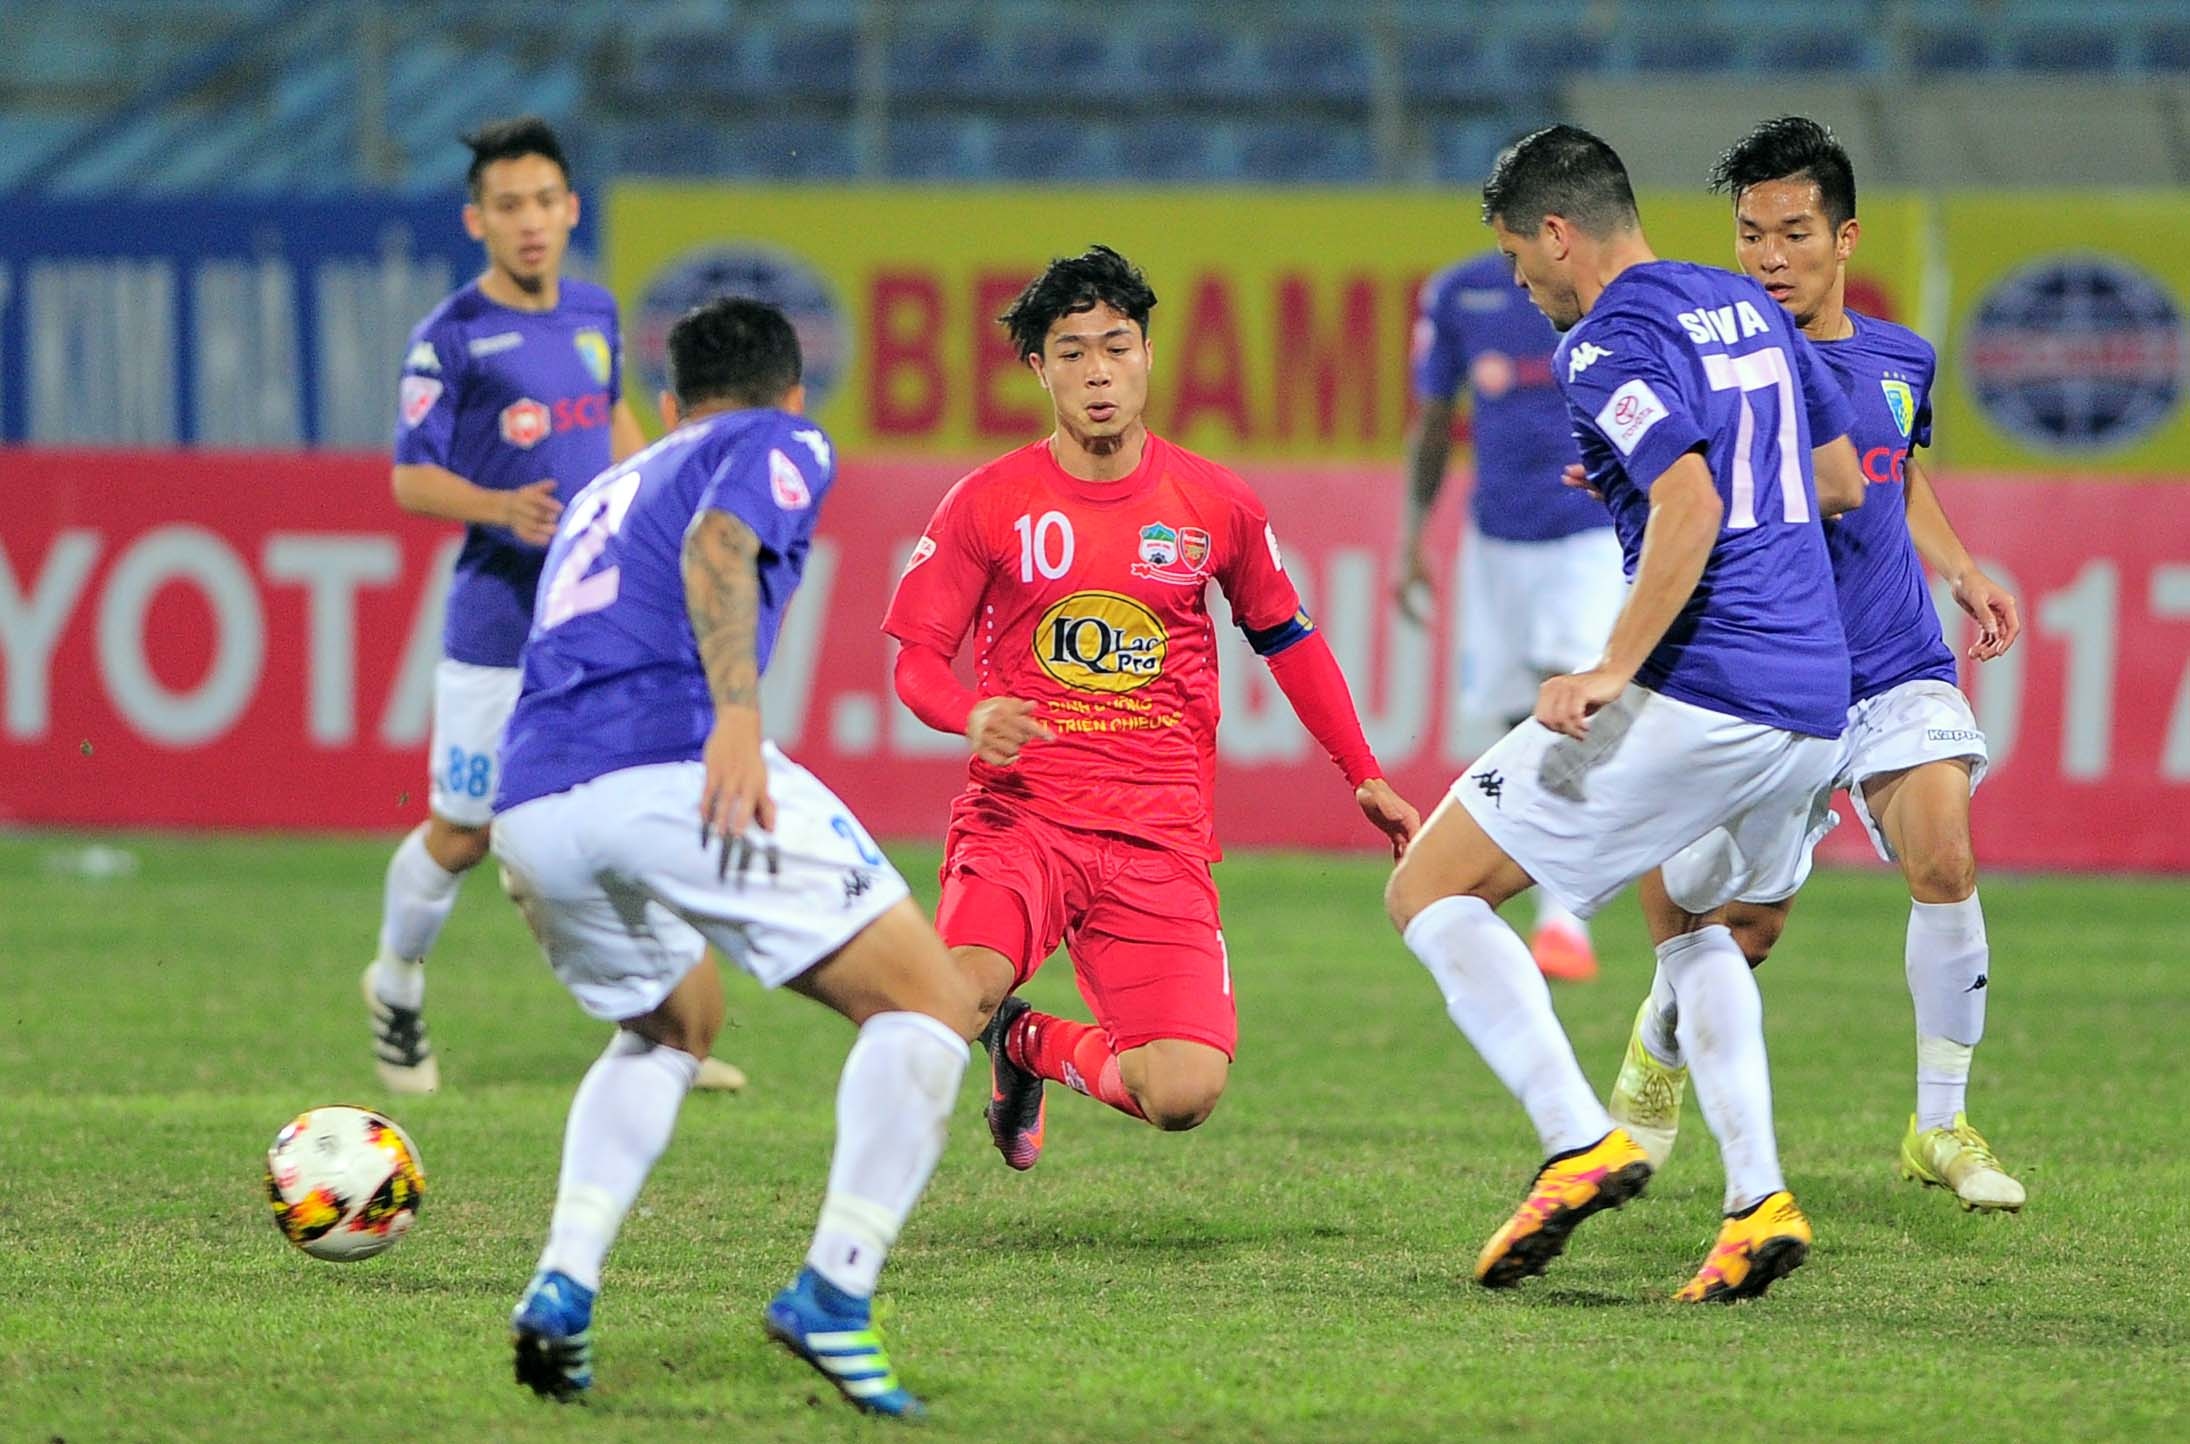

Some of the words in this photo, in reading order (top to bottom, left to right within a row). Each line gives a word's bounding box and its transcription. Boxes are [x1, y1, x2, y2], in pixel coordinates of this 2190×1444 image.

[1701, 347, 1810, 528] 77
[539, 470, 641, 632] 2
[1013, 510, 1075, 583] 10
[1049, 617, 1114, 674] IQ
[1118, 653, 1156, 674] Pro
[447, 746, 491, 798] 88
